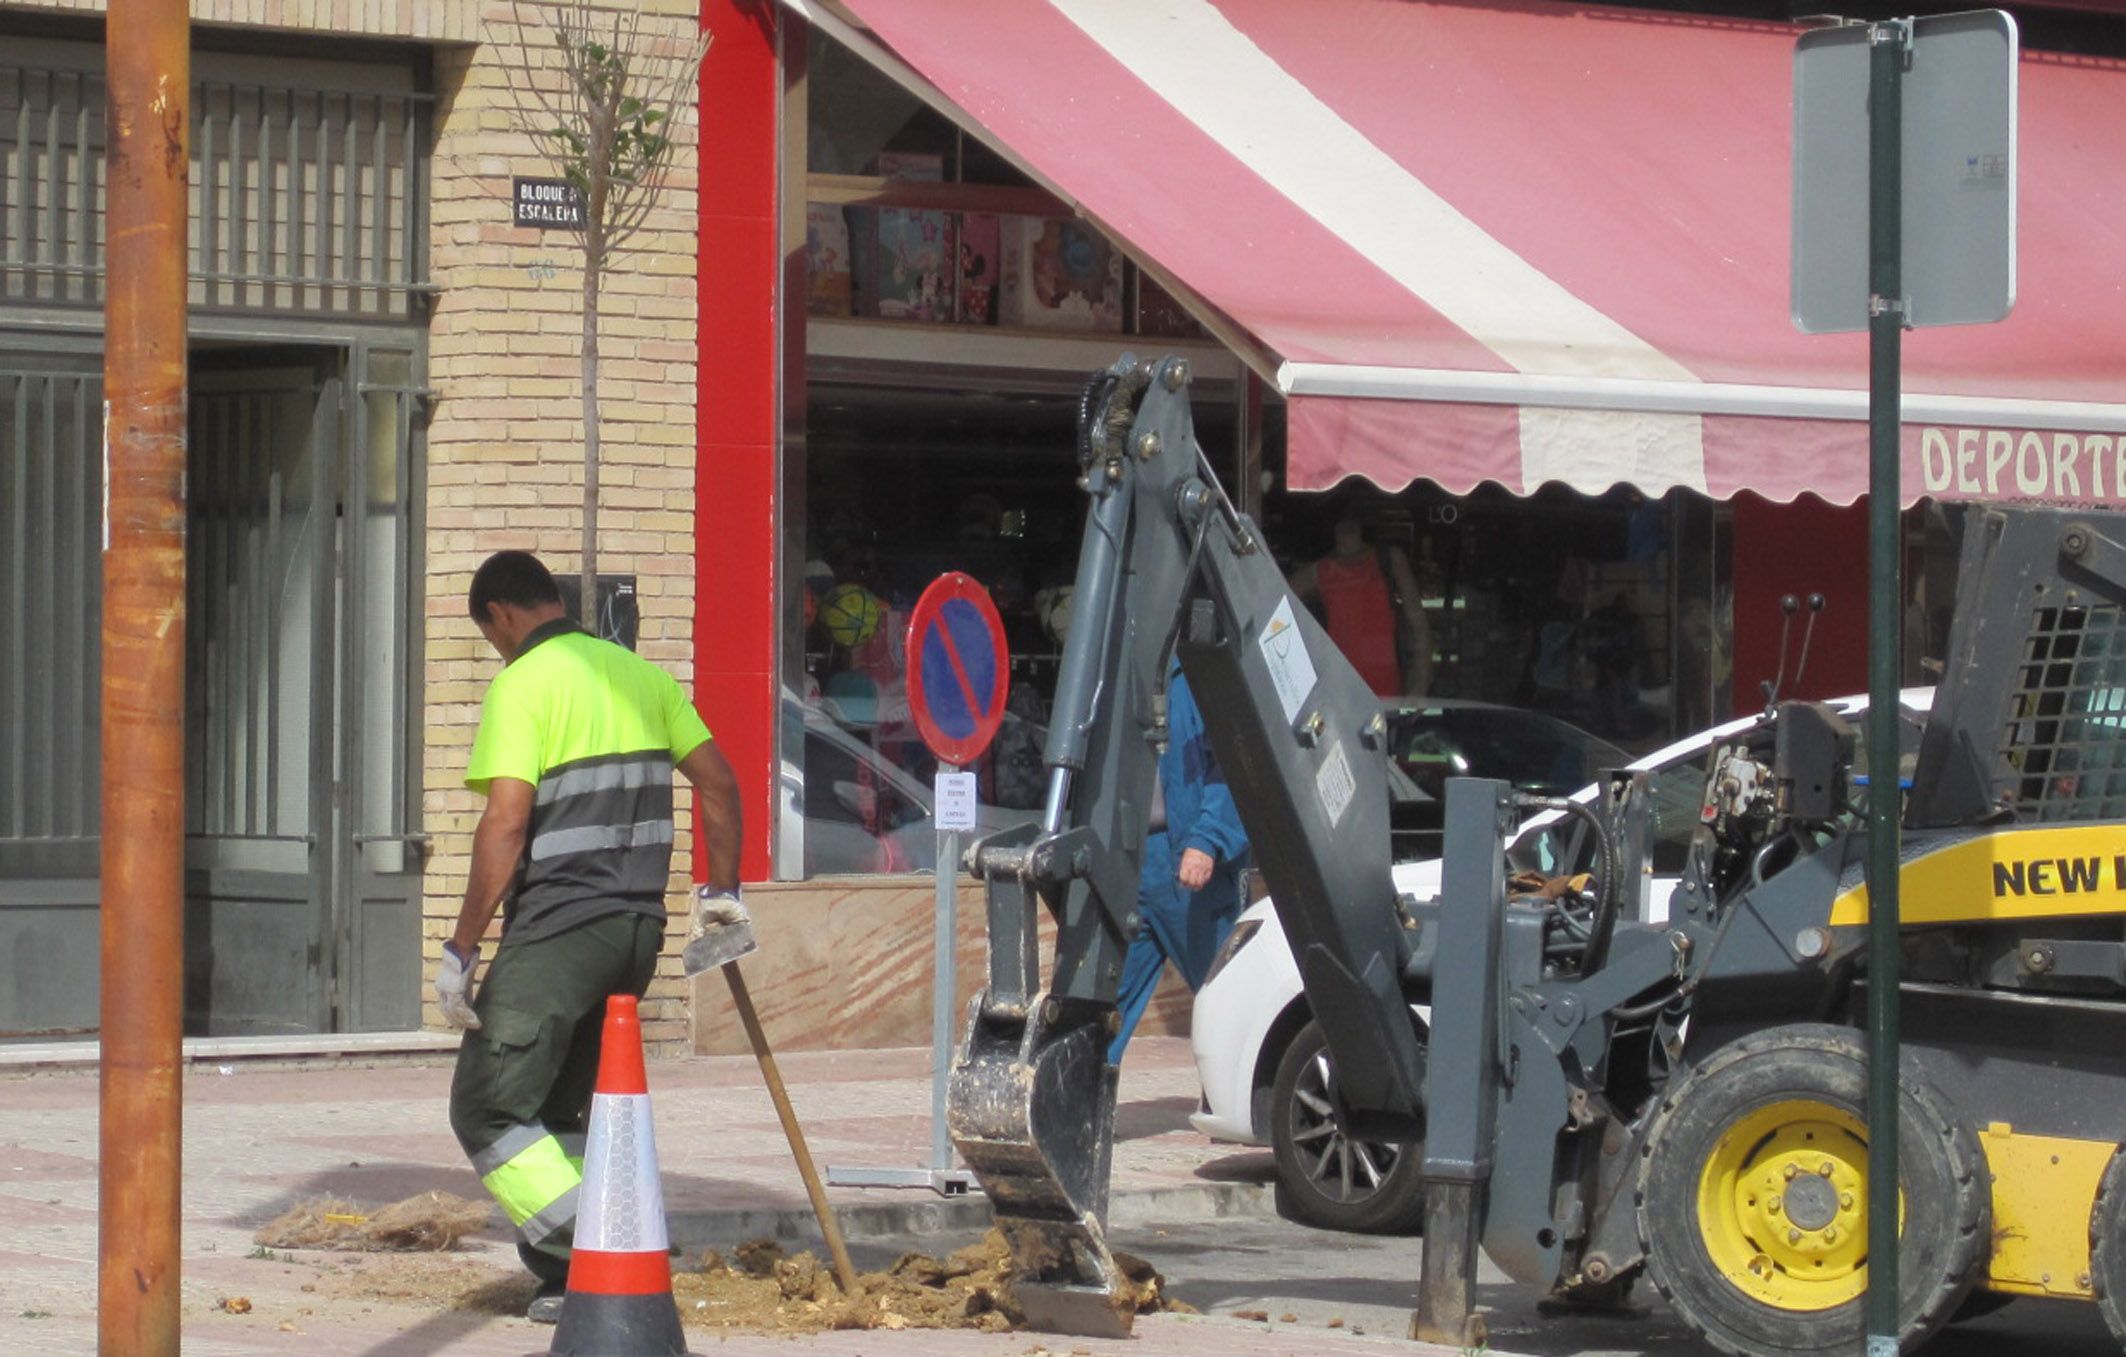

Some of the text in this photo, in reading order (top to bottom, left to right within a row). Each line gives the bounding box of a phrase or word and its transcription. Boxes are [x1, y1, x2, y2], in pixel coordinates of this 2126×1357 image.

[520, 184, 565, 202] BLOQUE
[518, 204, 579, 222] ESCALERA
[1992, 856, 2101, 897] NEW
